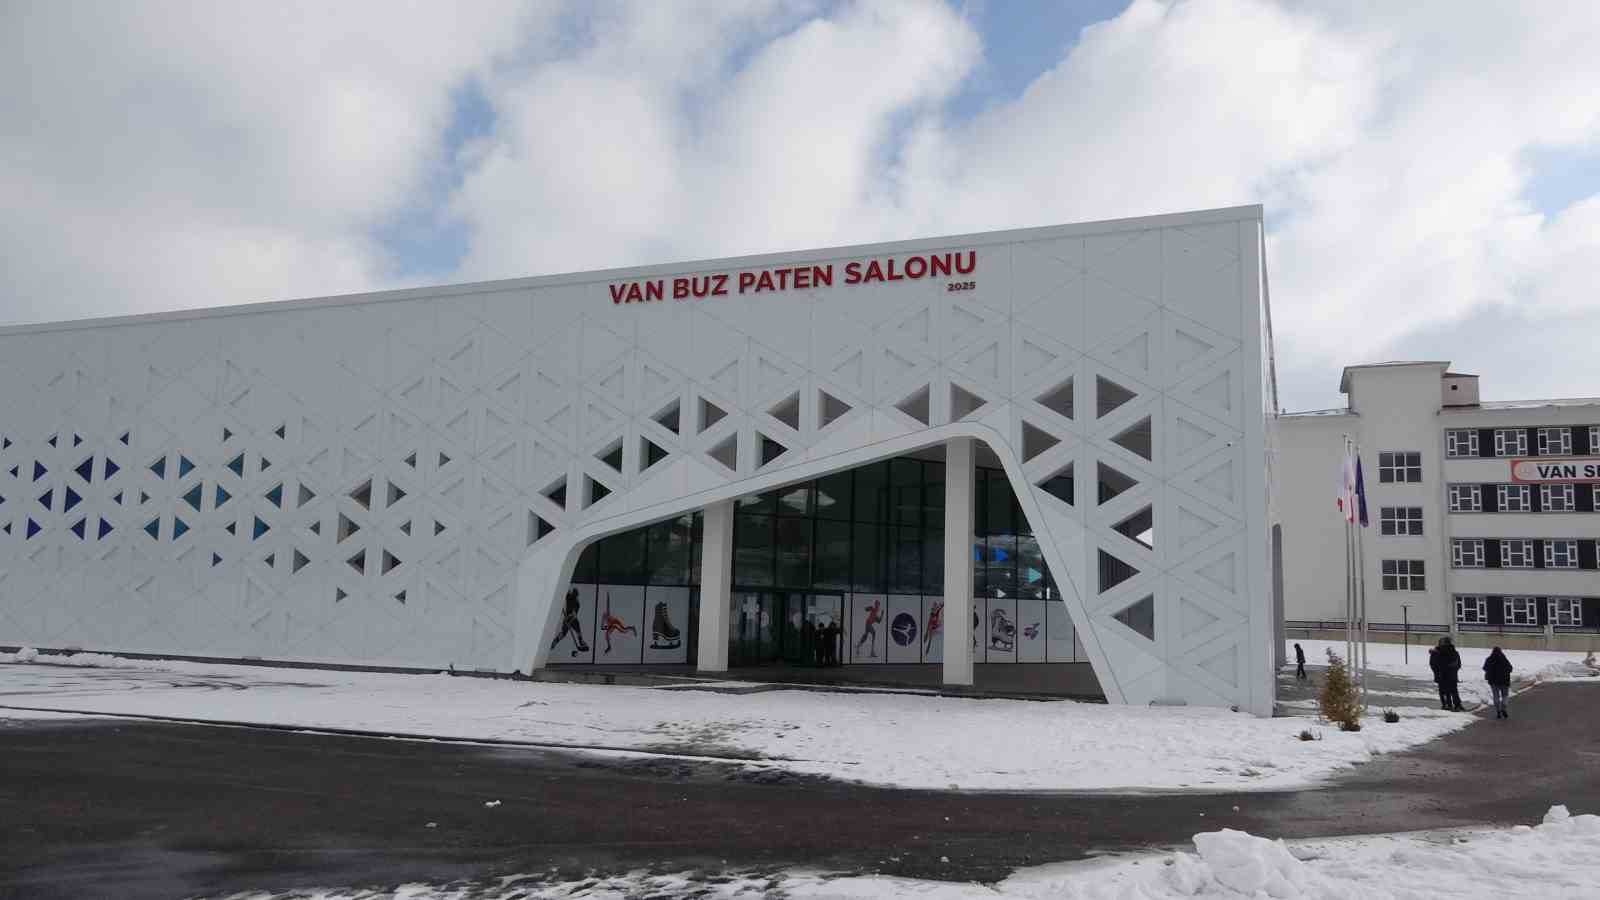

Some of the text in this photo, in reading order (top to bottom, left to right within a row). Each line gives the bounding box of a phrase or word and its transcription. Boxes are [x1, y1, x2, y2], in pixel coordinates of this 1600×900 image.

[610, 250, 977, 304] VAN BUZ PATEN SALONU
[946, 281, 977, 292] 2025
[1537, 465, 1577, 479] VAN
